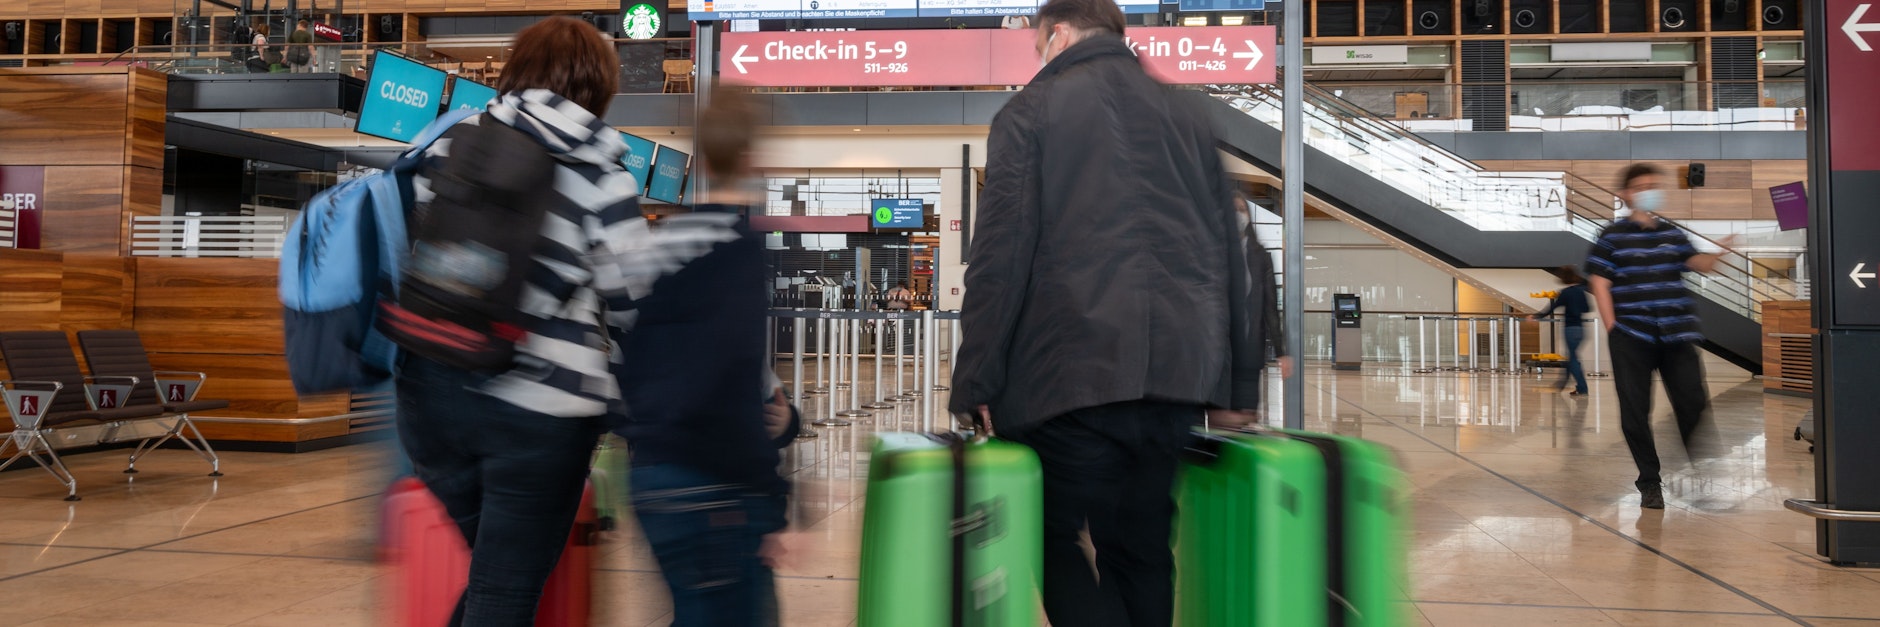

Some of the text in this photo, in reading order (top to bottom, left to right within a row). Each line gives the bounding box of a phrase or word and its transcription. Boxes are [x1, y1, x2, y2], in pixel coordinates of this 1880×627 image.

[845, 10, 885, 18] Maskenpflicht!
[764, 40, 858, 60] Check-in
[1125, 36, 1171, 57] k-in
[380, 80, 429, 109] CLOSED
[660, 163, 680, 179] CLOSED
[3, 193, 36, 210] BER
